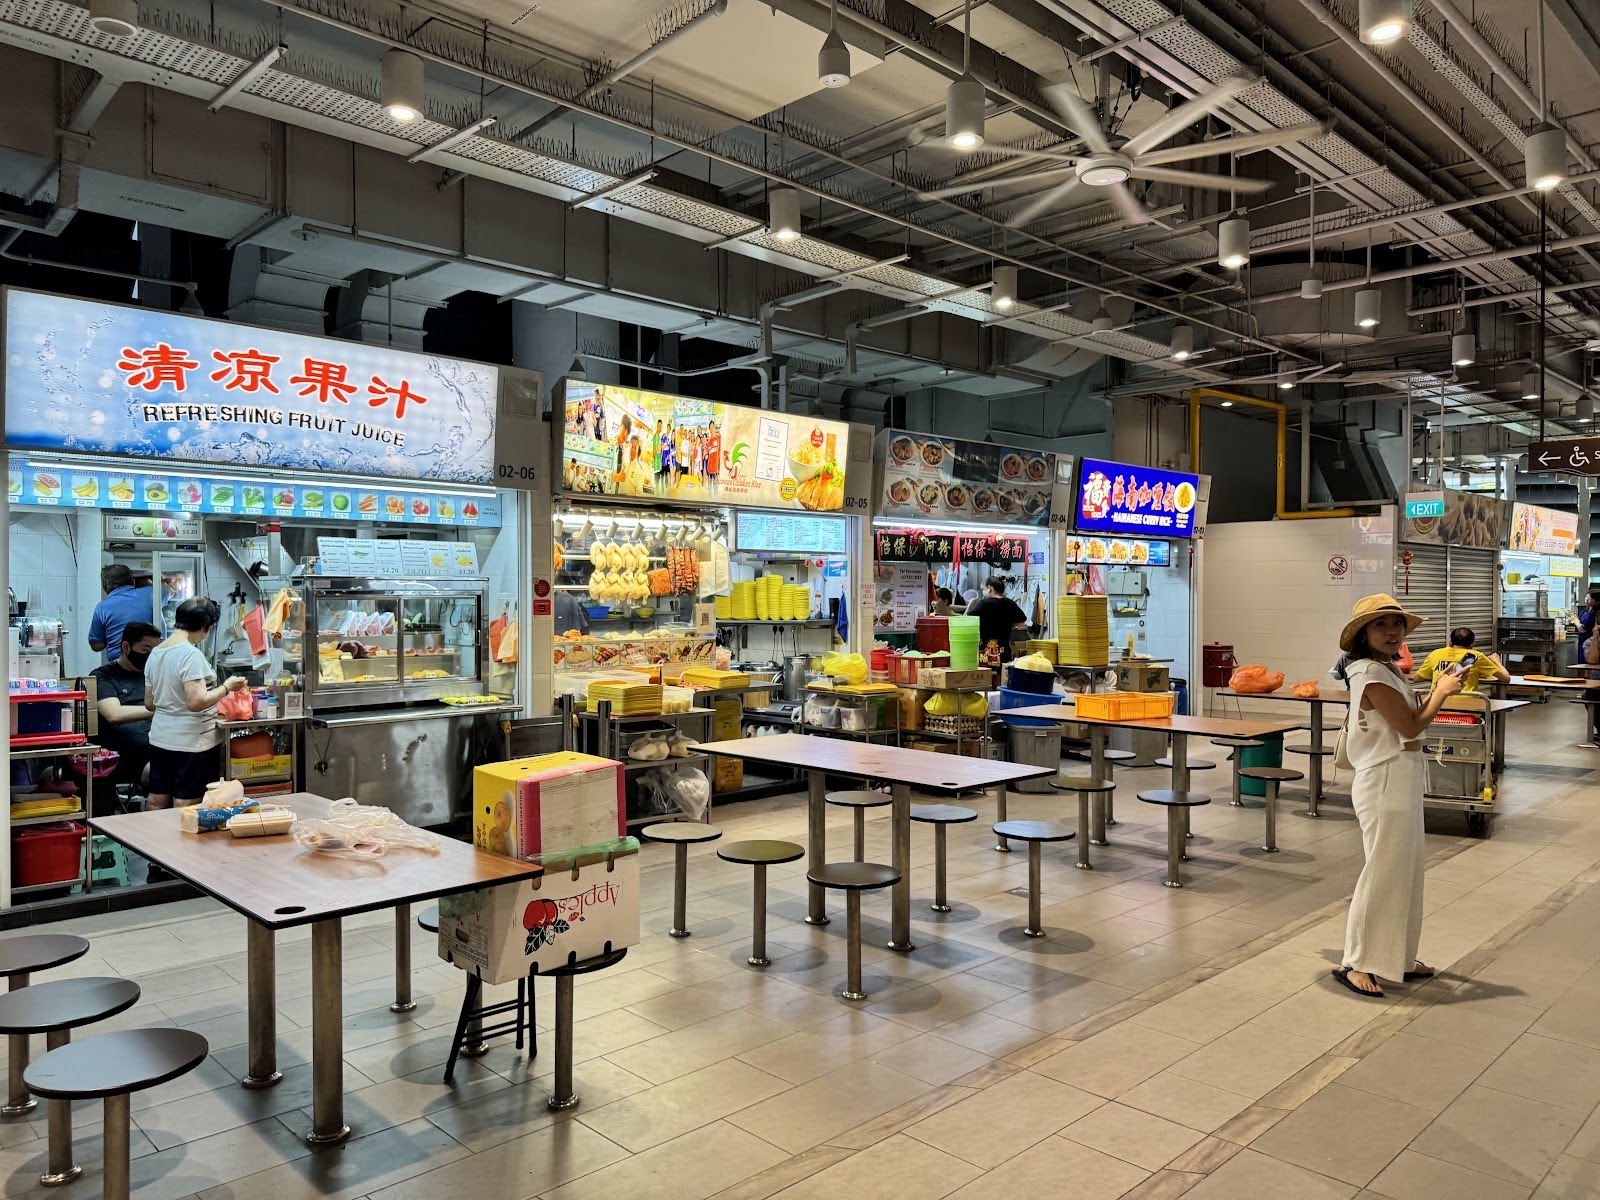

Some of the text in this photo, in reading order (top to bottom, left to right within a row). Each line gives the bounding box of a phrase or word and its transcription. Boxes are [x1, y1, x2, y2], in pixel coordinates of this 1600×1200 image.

[117, 344, 427, 419] 清凉果汁
[143, 404, 405, 447] REFRESHING FRUIT JUICE
[499, 464, 535, 480] 02-06
[845, 497, 868, 509] 02-05
[1417, 502, 1439, 515] EXIT
[558, 881, 621, 916] Apples
